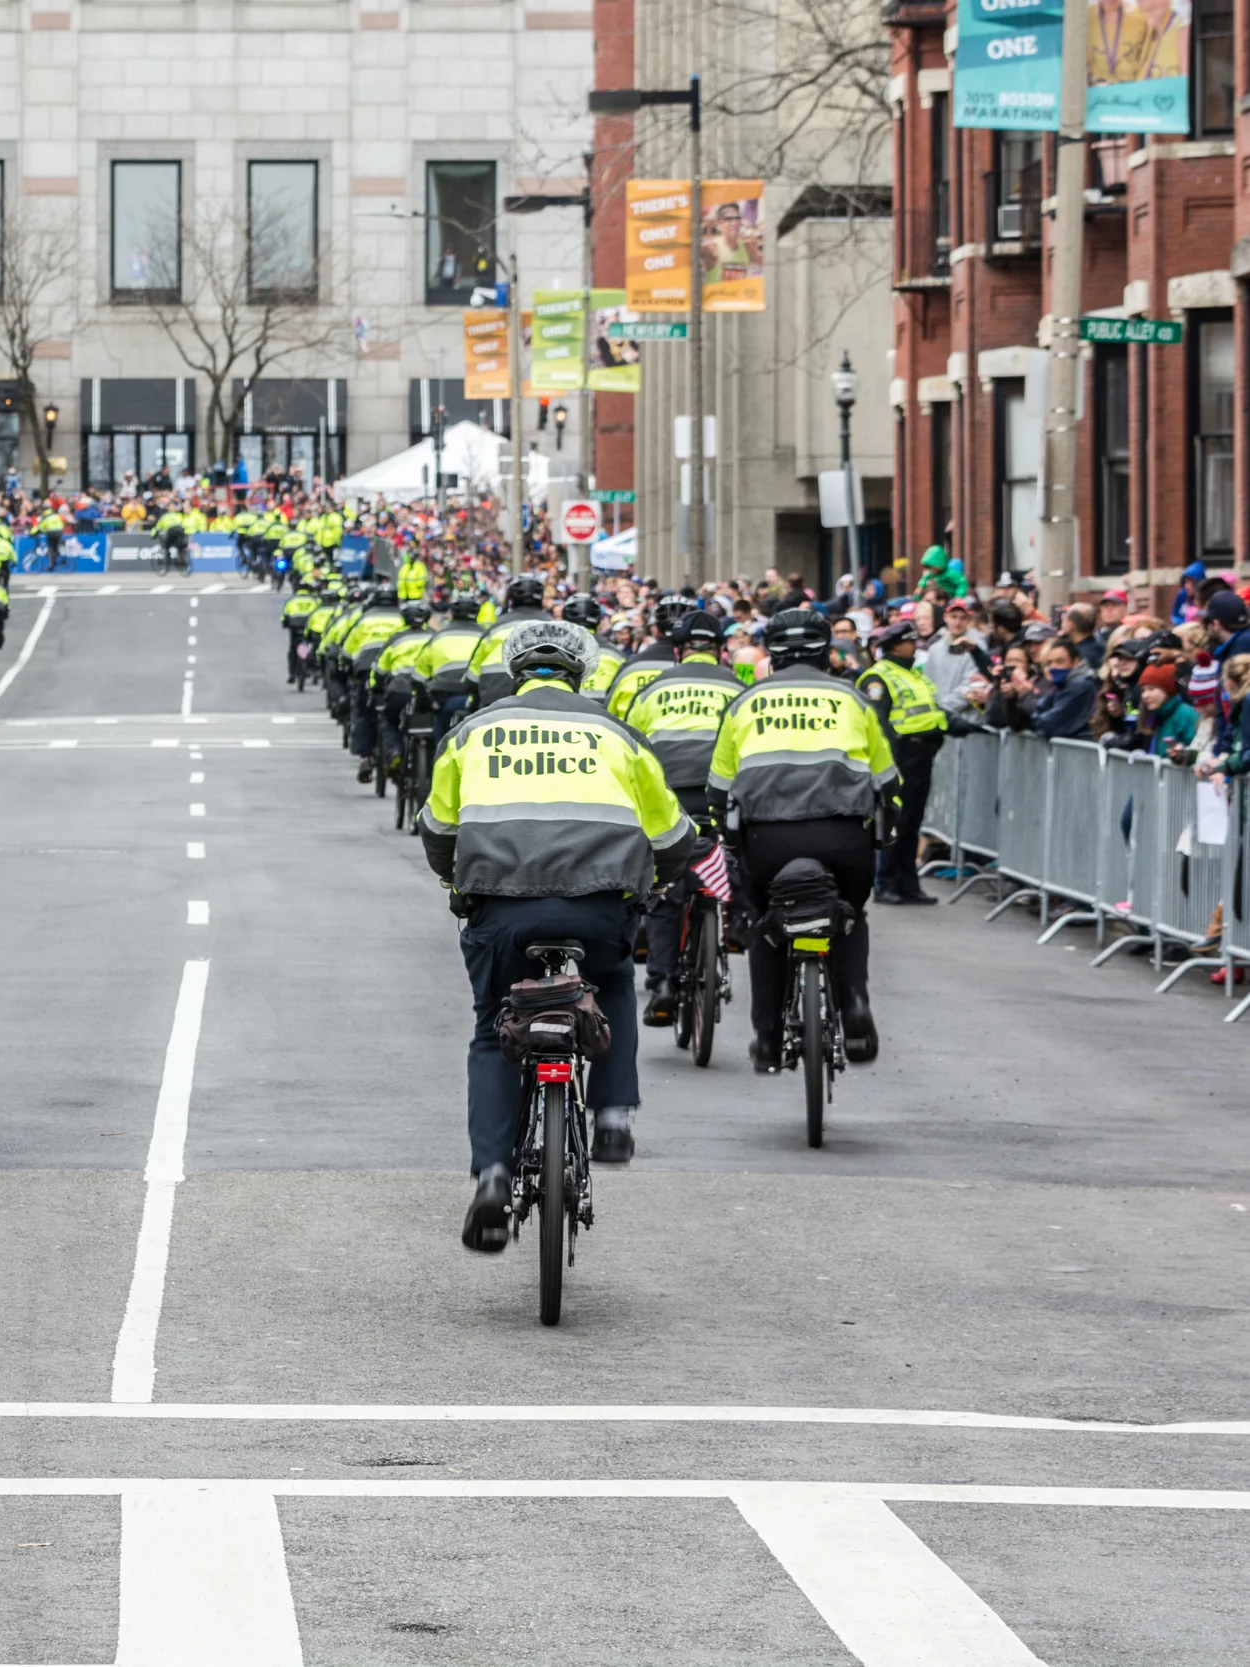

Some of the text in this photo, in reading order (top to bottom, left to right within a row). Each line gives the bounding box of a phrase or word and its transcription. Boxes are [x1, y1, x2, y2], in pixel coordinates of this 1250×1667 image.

[987, 35, 1038, 59] ONE
[965, 92, 1055, 107] 2015 BOSTON
[963, 106, 1054, 120] MARATHON
[630, 194, 688, 215] THERE'S
[639, 225, 677, 243] ONLY
[644, 254, 675, 271] ONE
[1087, 321, 1122, 340] PUBLIC
[1125, 322, 1155, 341] ALLEY
[751, 693, 842, 715] Quincy
[755, 713, 837, 735] Police
[482, 725, 602, 753] Quincy
[488, 751, 597, 778] Police
